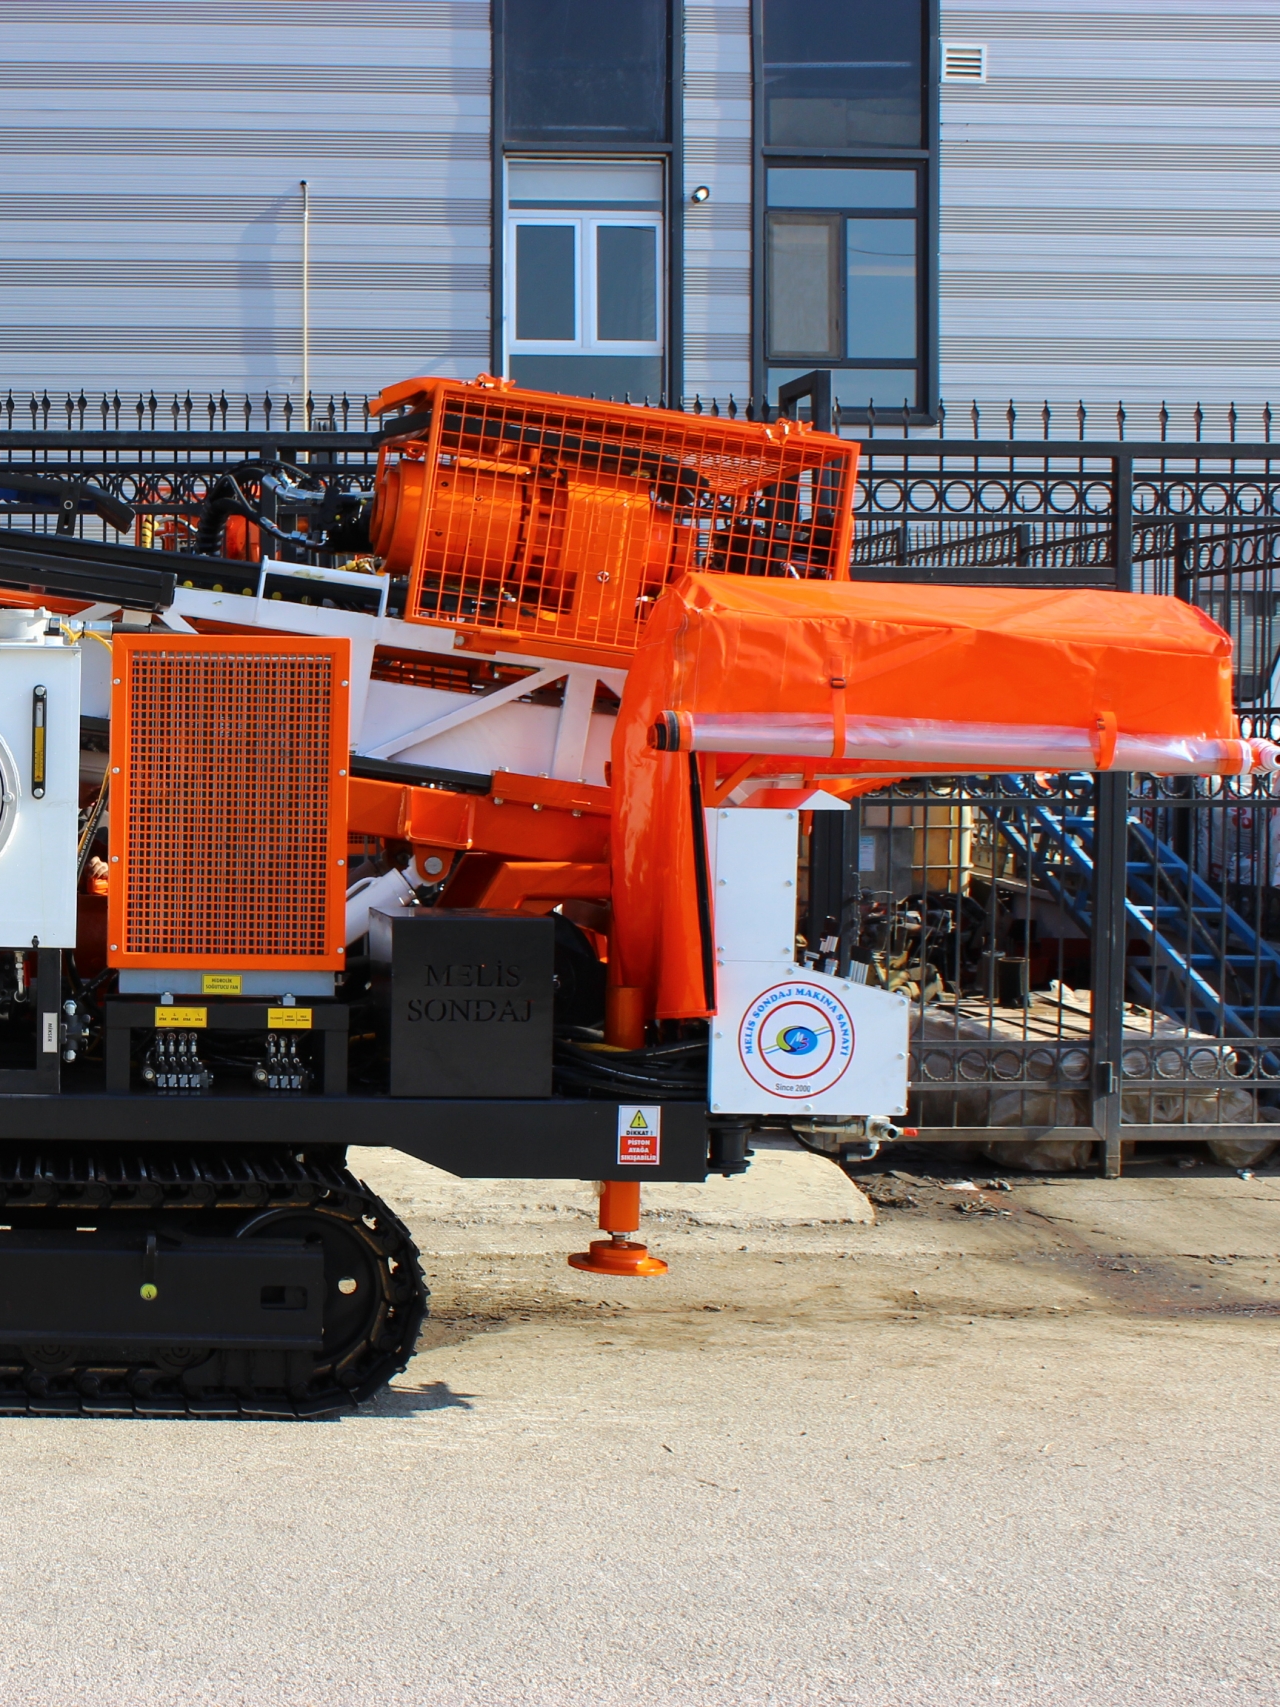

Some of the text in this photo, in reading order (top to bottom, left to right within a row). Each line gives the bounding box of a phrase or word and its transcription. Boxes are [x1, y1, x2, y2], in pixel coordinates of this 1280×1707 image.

[424, 960, 522, 987] MELİS
[407, 999, 534, 1022] SONDAJ
[745, 1020, 756, 1055] MELİS
[752, 988, 793, 1019] SONDAJ
[795, 987, 838, 1014] MAKİNA
[775, 1083, 794, 1091] Since
